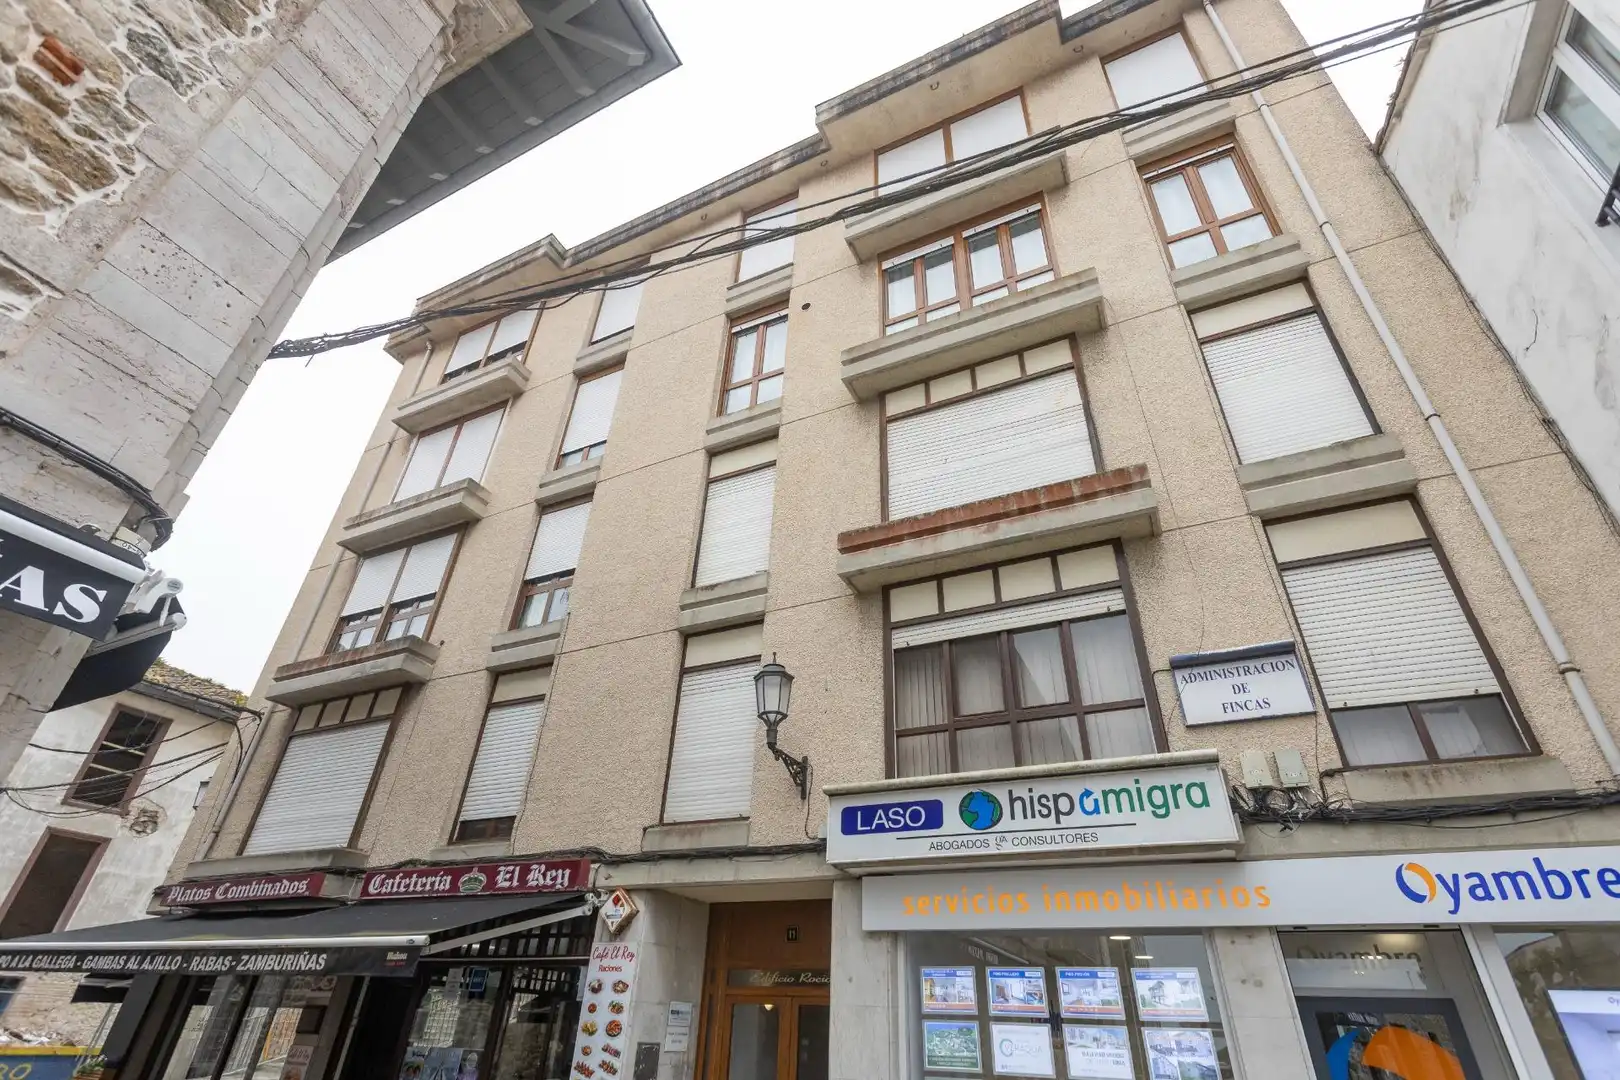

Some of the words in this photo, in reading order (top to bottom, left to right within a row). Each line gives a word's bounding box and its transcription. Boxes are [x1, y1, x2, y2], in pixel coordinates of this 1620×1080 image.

[0, 538, 107, 623] AS
[1180, 659, 1296, 685] ADMINISTRACION
[1232, 682, 1251, 695] DE
[1221, 697, 1271, 714] FINCAS
[1008, 778, 1211, 824] hispamigra
[857, 806, 926, 831] LASO
[929, 838, 990, 851] ABOGADOS
[1012, 832, 1099, 847] CONSULTORES
[167, 885, 214, 903] Platos
[215, 878, 310, 899] Combinados
[368, 870, 452, 895] Cafetería
[495, 865, 520, 888] El
[526, 864, 571, 889] Rey
[1396, 856, 1620, 915] Oyambre
[903, 885, 1030, 916] servicios
[1041, 878, 1271, 912] inmobiliarios
[32, 955, 77, 969] GALLEGA
[82, 955, 127, 969] GAMBAS
[125, 955, 141, 970] AL
[140, 955, 182, 970] AJILLO
[593, 946, 609, 963] Café
[610, 945, 621, 960] El
[621, 945, 635, 962] Rey
